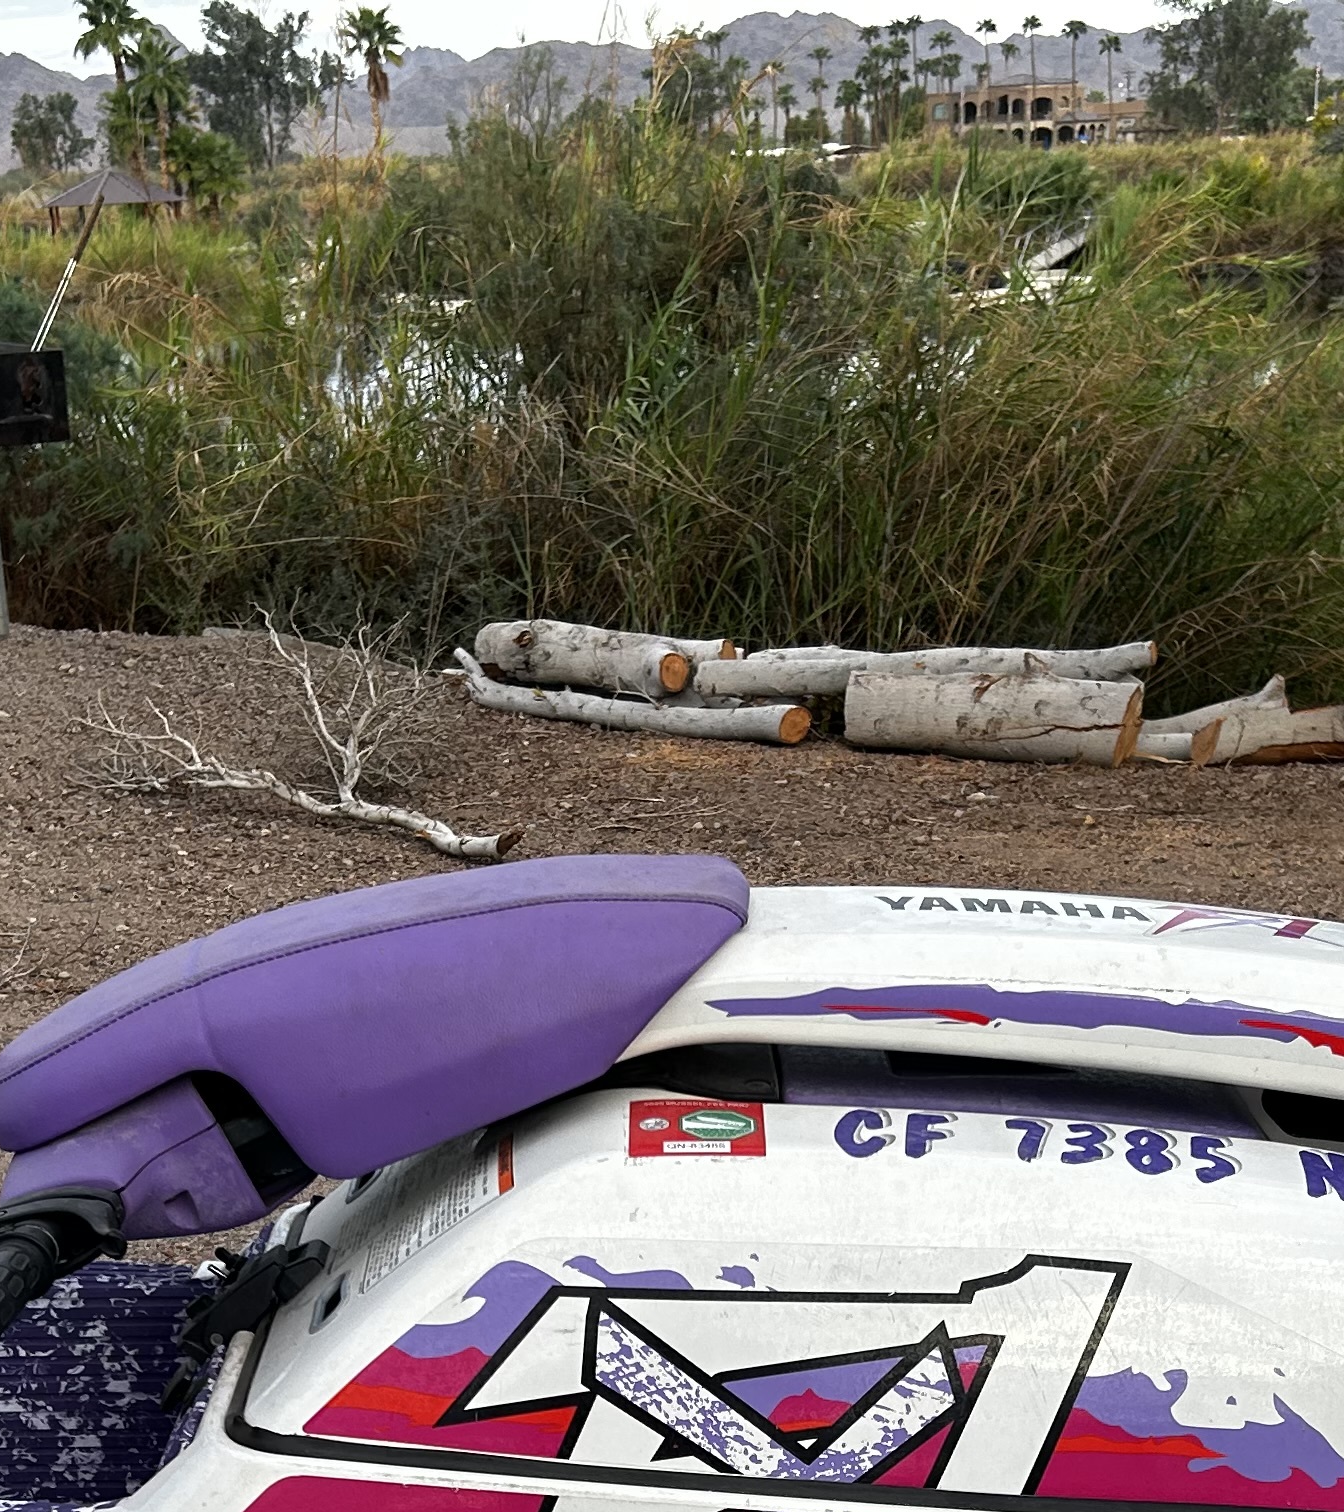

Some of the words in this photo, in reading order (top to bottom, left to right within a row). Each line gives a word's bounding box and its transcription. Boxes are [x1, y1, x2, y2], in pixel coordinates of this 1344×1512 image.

[875, 896, 1153, 923] YAMAHA
[834, 1108, 958, 1159] CF
[1005, 1118, 1243, 1184] 7385
